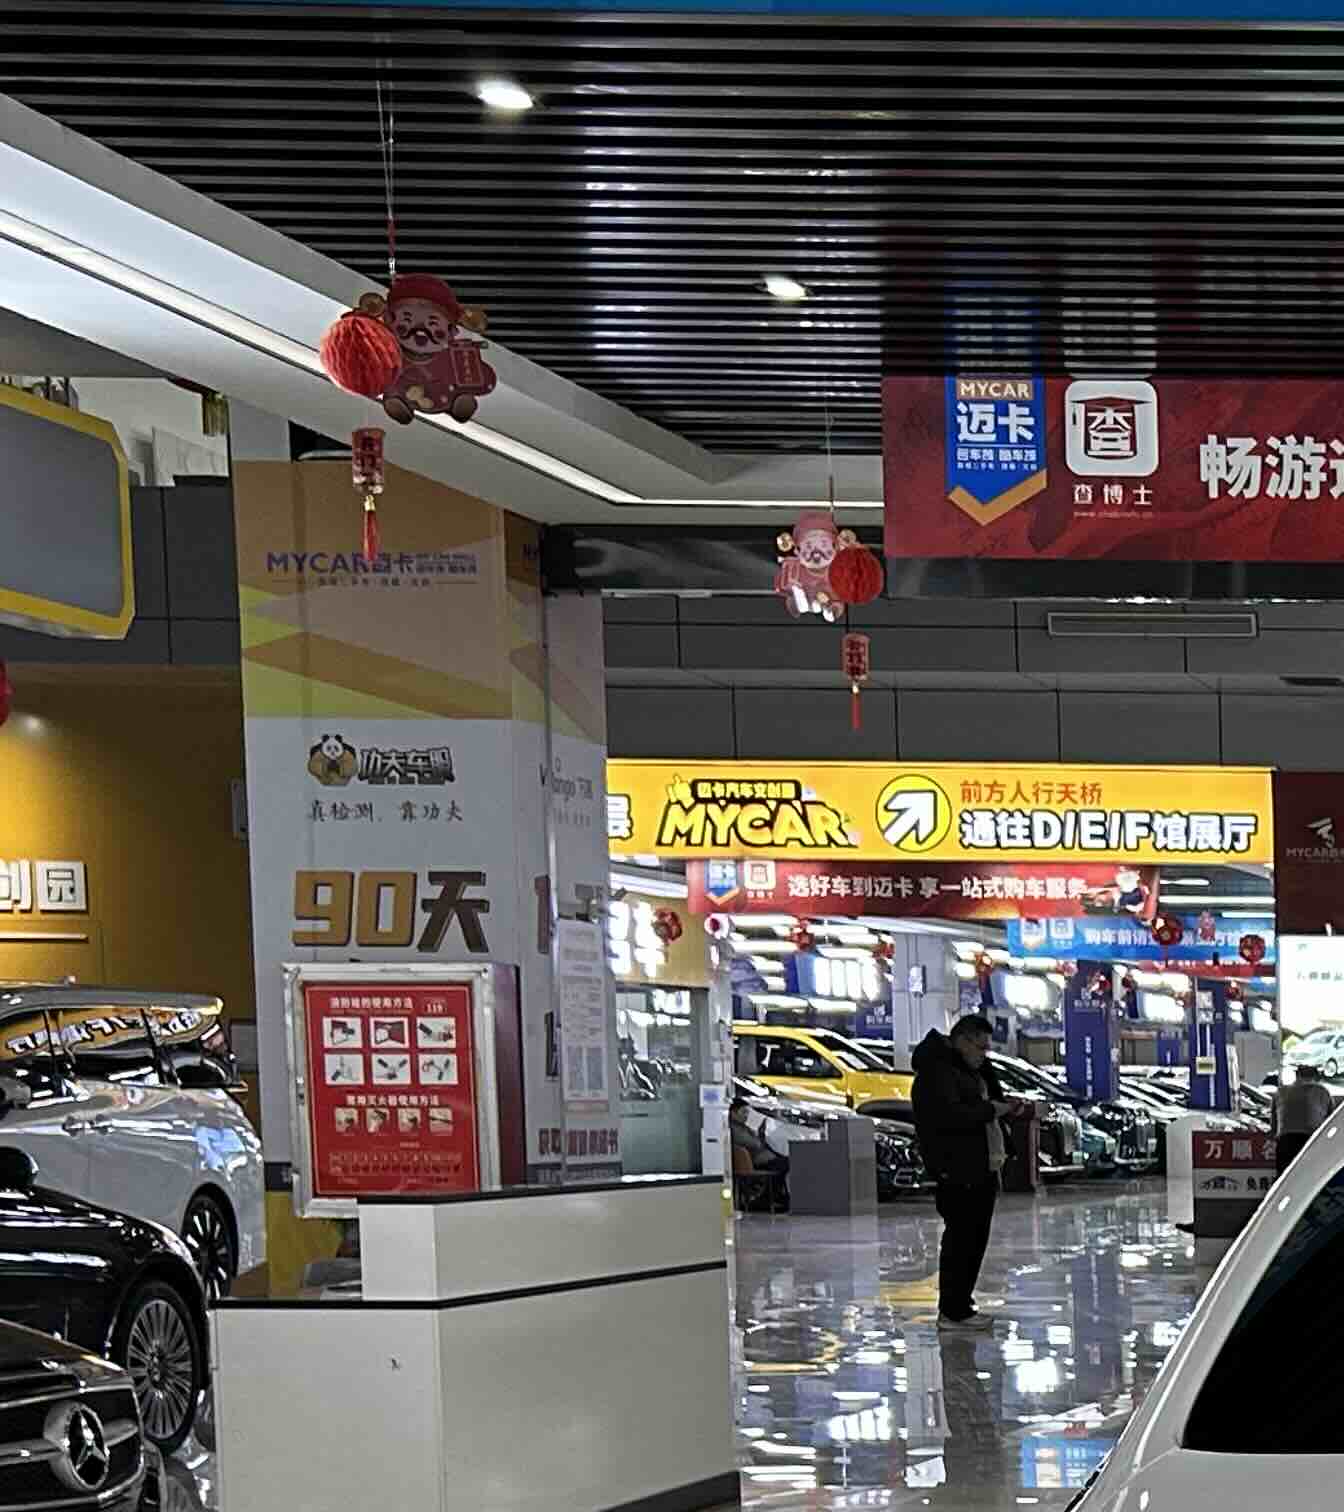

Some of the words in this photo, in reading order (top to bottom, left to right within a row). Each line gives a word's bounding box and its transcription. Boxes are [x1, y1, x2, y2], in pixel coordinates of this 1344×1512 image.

[959, 382, 1030, 398] MYCAR
[956, 402, 1035, 443] 迈卡
[1073, 483, 1153, 505] 查博士
[960, 780, 1103, 805] 前方人行天桥
[655, 800, 857, 848] MYCAR
[787, 874, 914, 898] 选好车到迈卡
[291, 870, 490, 954] 90天
